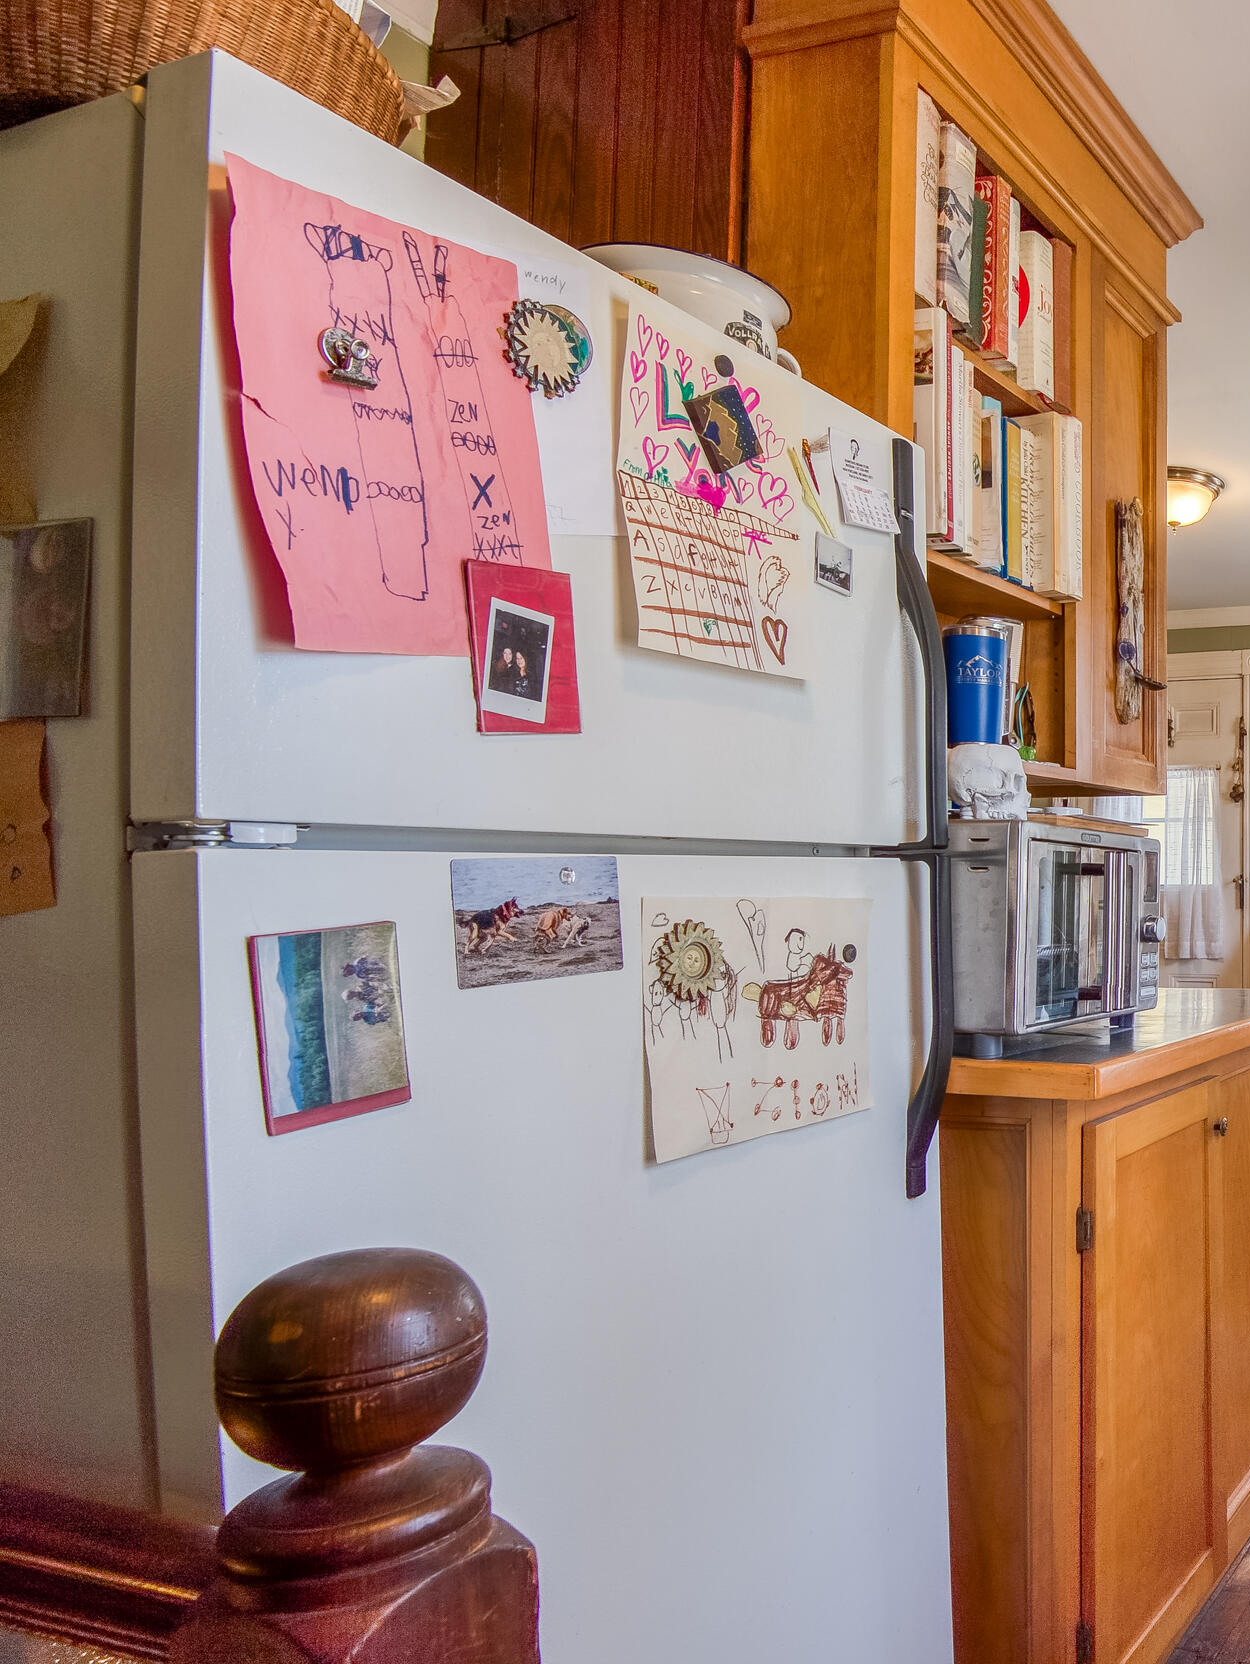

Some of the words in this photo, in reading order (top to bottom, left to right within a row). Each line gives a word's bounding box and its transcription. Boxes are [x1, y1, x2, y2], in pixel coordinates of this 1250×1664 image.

[524, 271, 566, 294] wendy
[1020, 477, 1029, 539] KITCHEN
[957, 667, 1001, 678] TAYLOR
